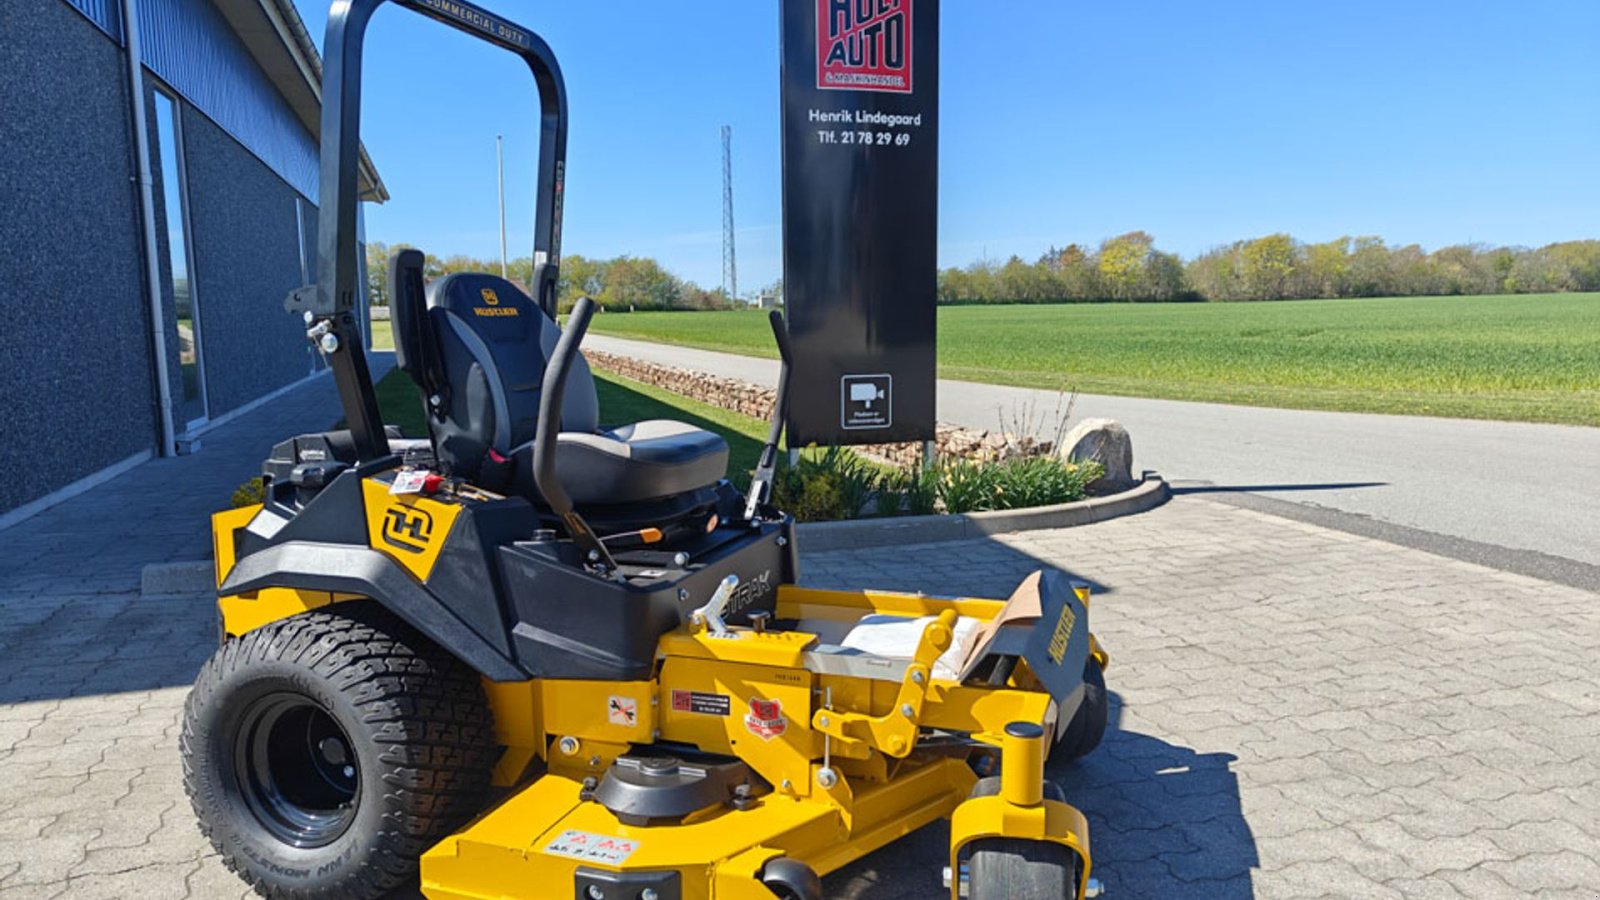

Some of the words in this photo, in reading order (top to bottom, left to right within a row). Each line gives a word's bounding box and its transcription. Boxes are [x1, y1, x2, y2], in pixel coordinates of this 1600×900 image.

[498, 24, 524, 42] DUTY
[824, 11, 905, 70] AUTO
[808, 109, 853, 122] Henrik
[855, 110, 922, 127] Lindegaard
[818, 130, 838, 143] Tlf.
[841, 131, 855, 143] 21
[858, 132, 873, 144] 78
[876, 132, 892, 145] 29
[895, 133, 911, 146] 69
[1047, 603, 1076, 667] HUSTLER
